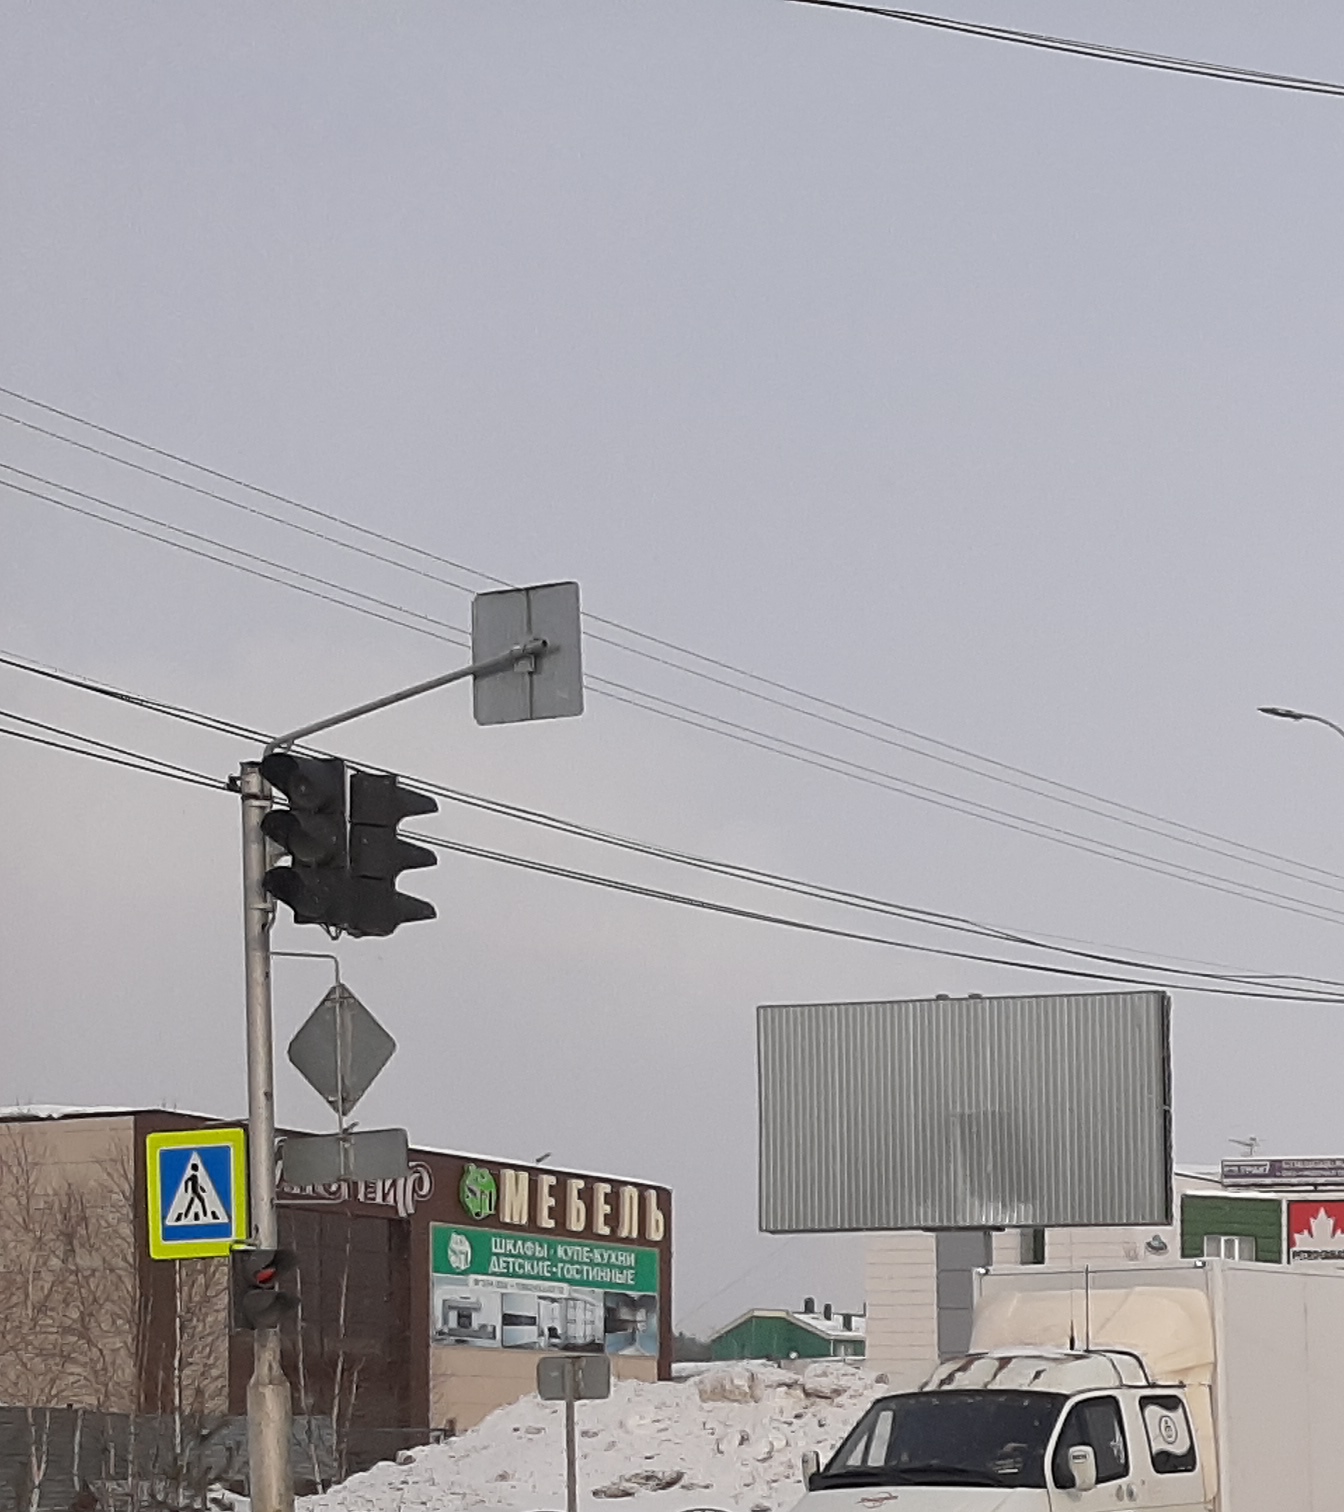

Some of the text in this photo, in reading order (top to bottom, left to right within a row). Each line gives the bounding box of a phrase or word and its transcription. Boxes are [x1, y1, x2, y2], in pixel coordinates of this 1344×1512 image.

[500, 1168, 665, 1241] МЕБЕЛЬ
[491, 1237, 548, 1258] ШКАФЫ
[488, 1256, 636, 1285] ДЕТСКИЕ ГОСТИННЫЕ
